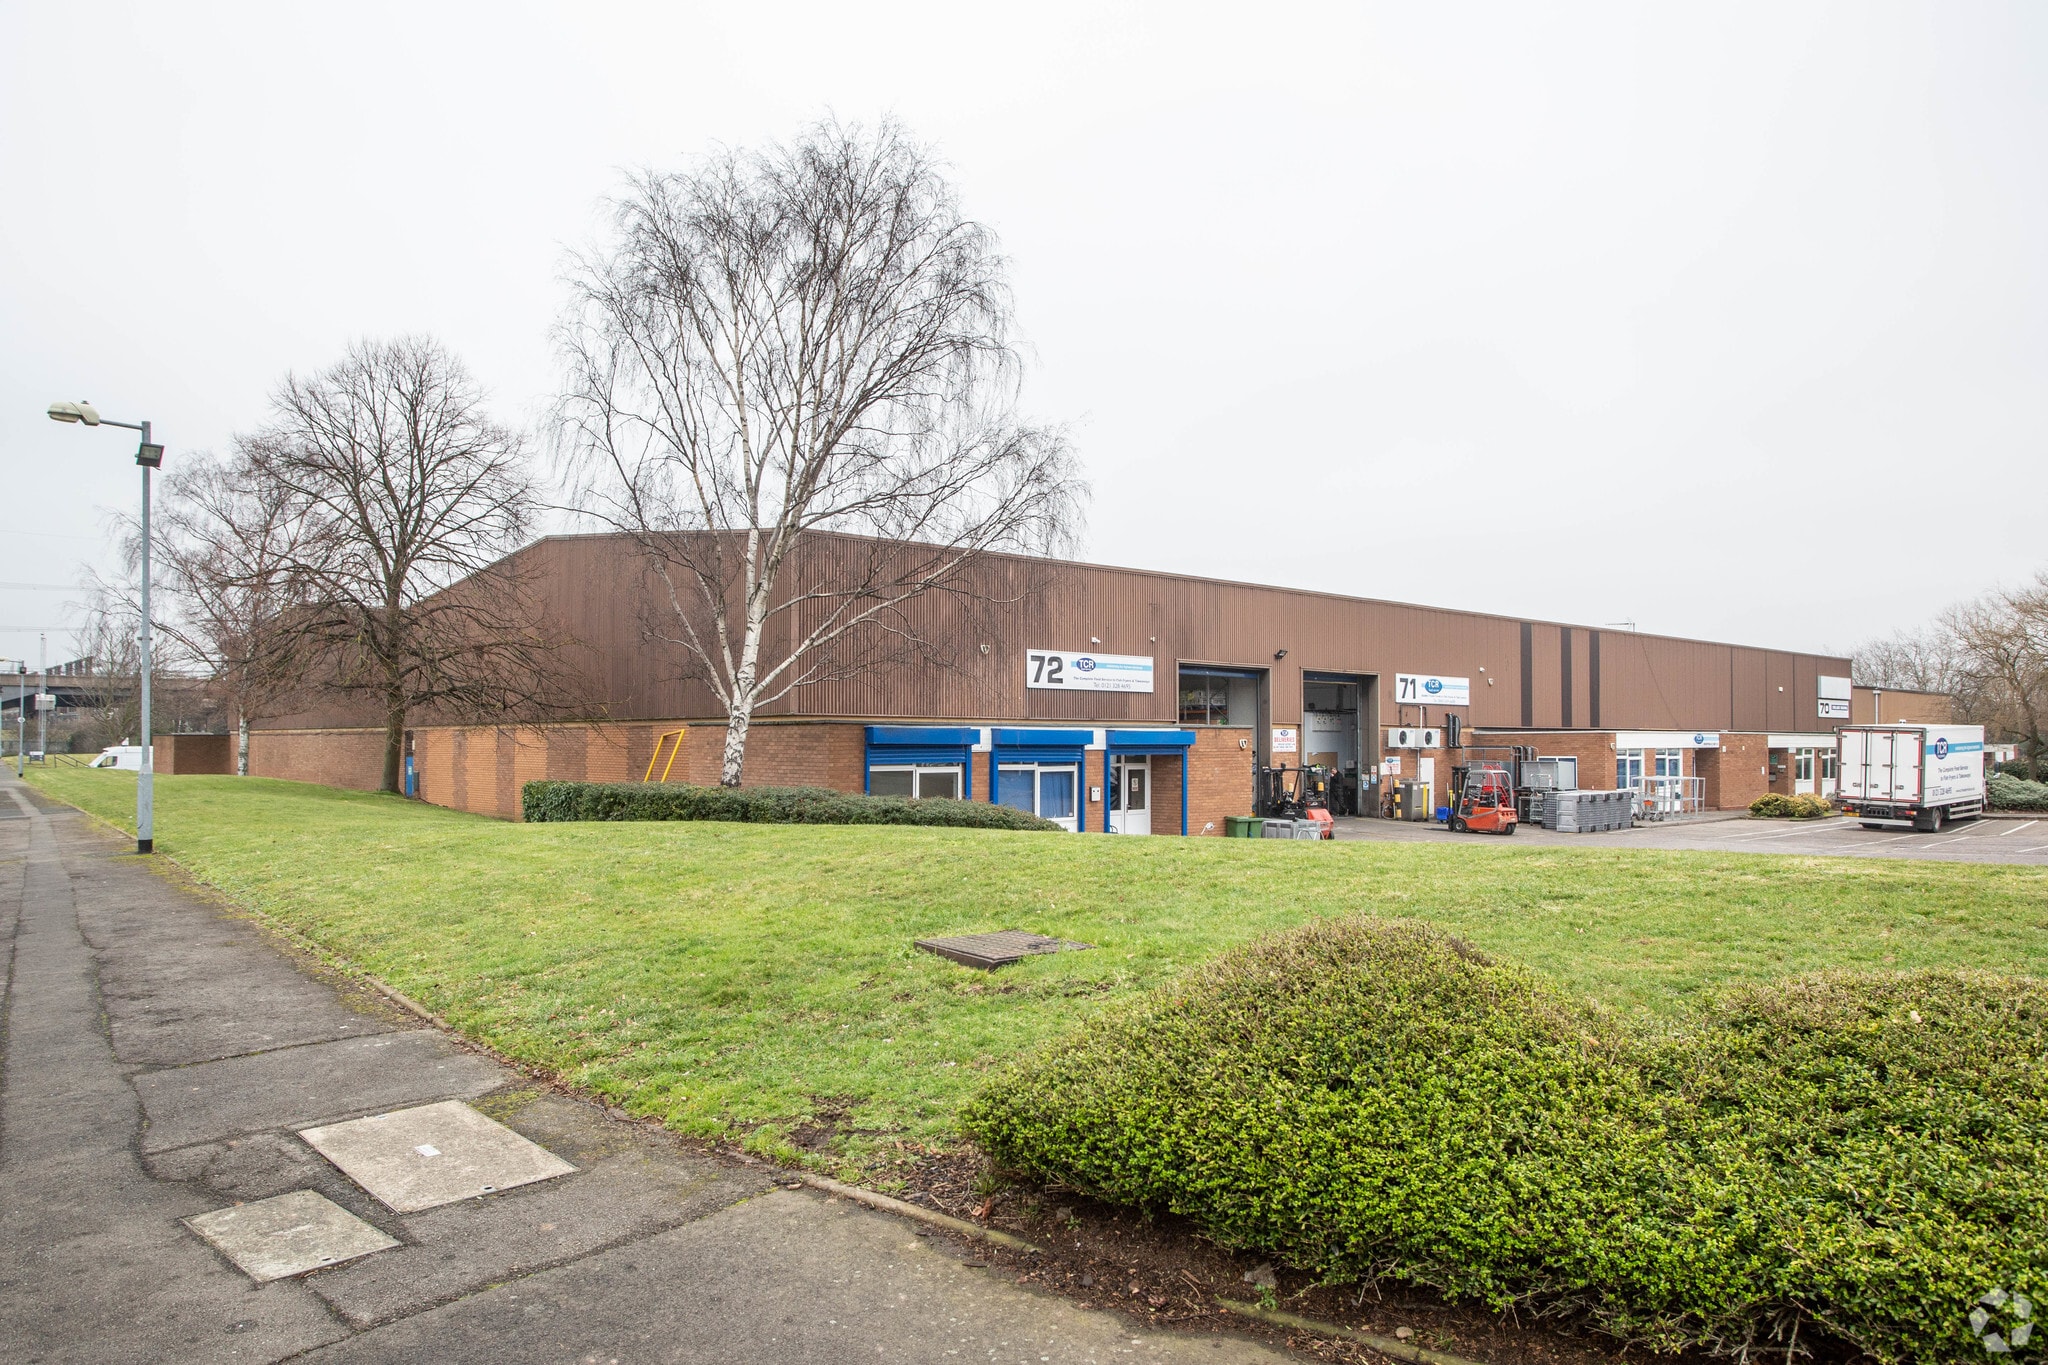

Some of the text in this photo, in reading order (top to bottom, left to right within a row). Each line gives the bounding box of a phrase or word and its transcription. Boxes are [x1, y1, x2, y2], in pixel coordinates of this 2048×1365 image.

[1030, 655, 1063, 684] 72
[1079, 659, 1094, 669] TCR
[1400, 678, 1416, 699] 71
[1427, 680, 1440, 688] TCR
[1820, 703, 1829, 714] 70
[1936, 742, 1948, 754] TCR
